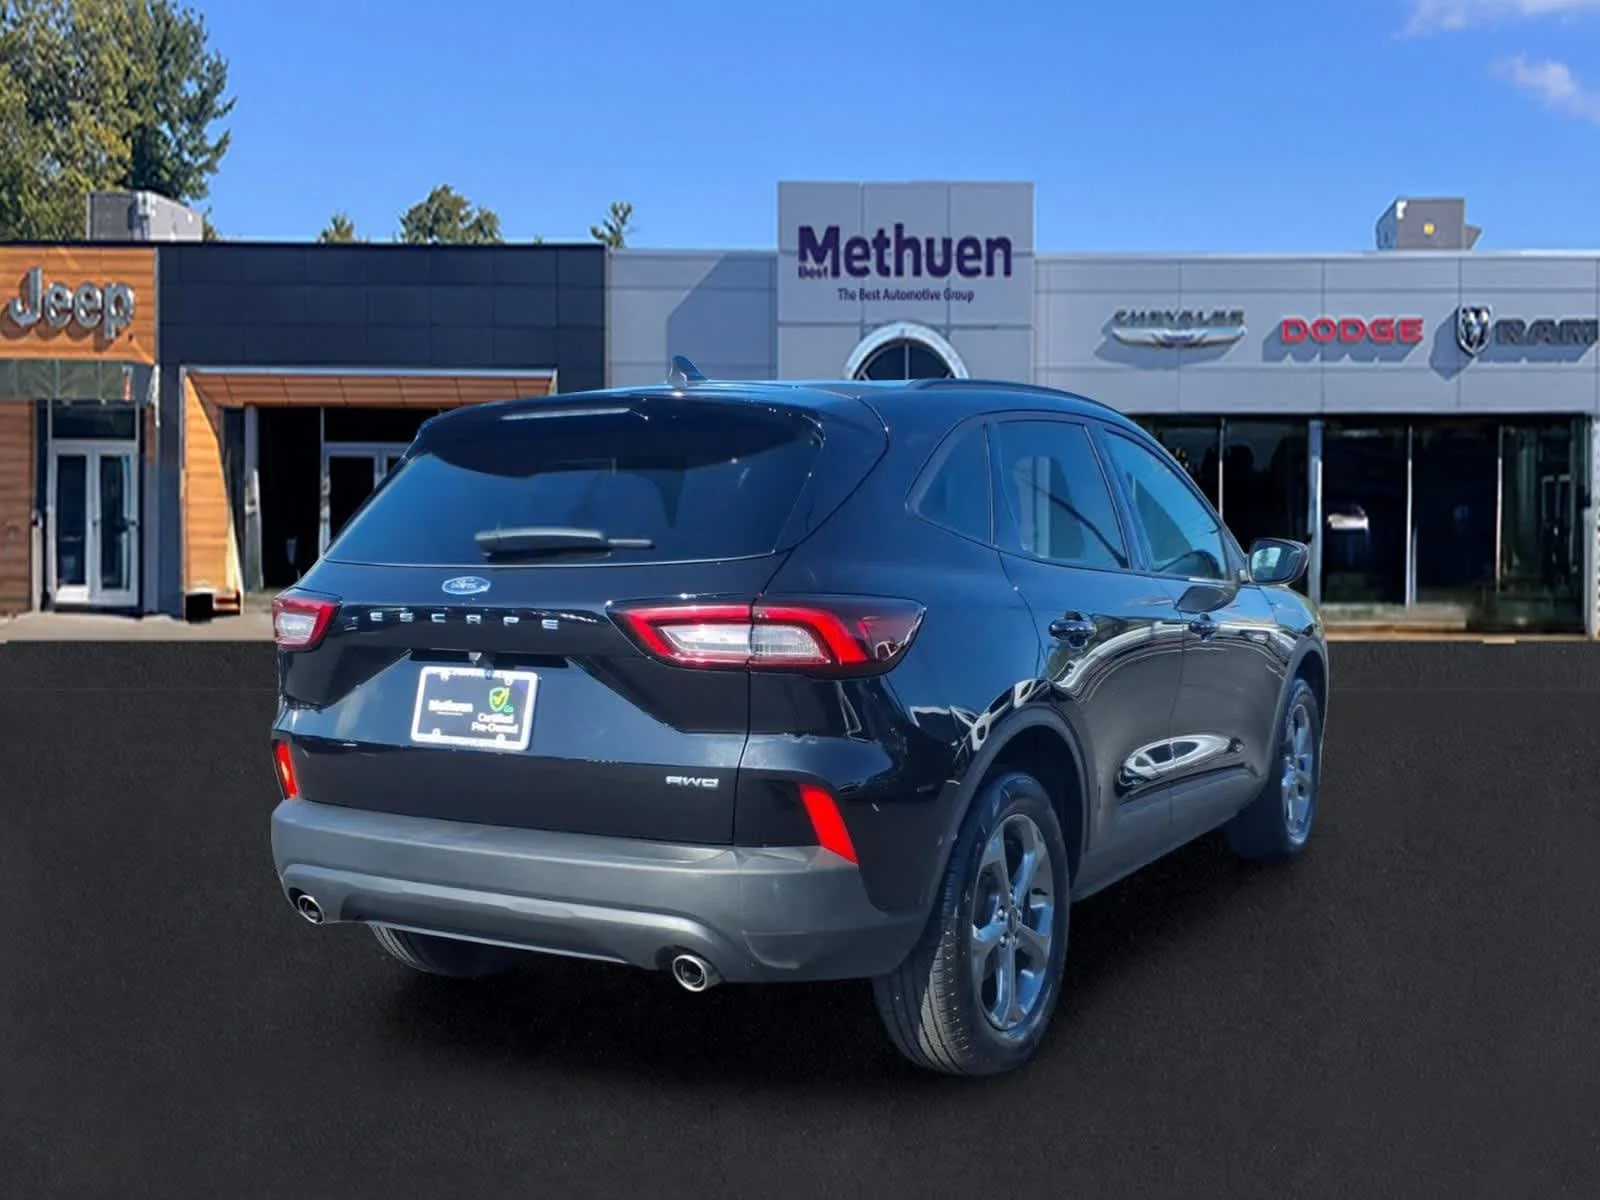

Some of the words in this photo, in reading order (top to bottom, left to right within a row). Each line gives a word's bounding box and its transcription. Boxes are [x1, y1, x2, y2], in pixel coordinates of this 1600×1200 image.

[798, 223, 1012, 278] Methuen
[9, 266, 135, 340] Jeep
[838, 288, 857, 301] The
[859, 288, 880, 301] Best
[883, 288, 940, 301] Automotive
[944, 288, 975, 304] Group
[1282, 317, 1423, 344] DODGE
[1499, 318, 1599, 346] RAM
[370, 611, 560, 631] ESCAPE
[665, 775, 720, 788] AWD
